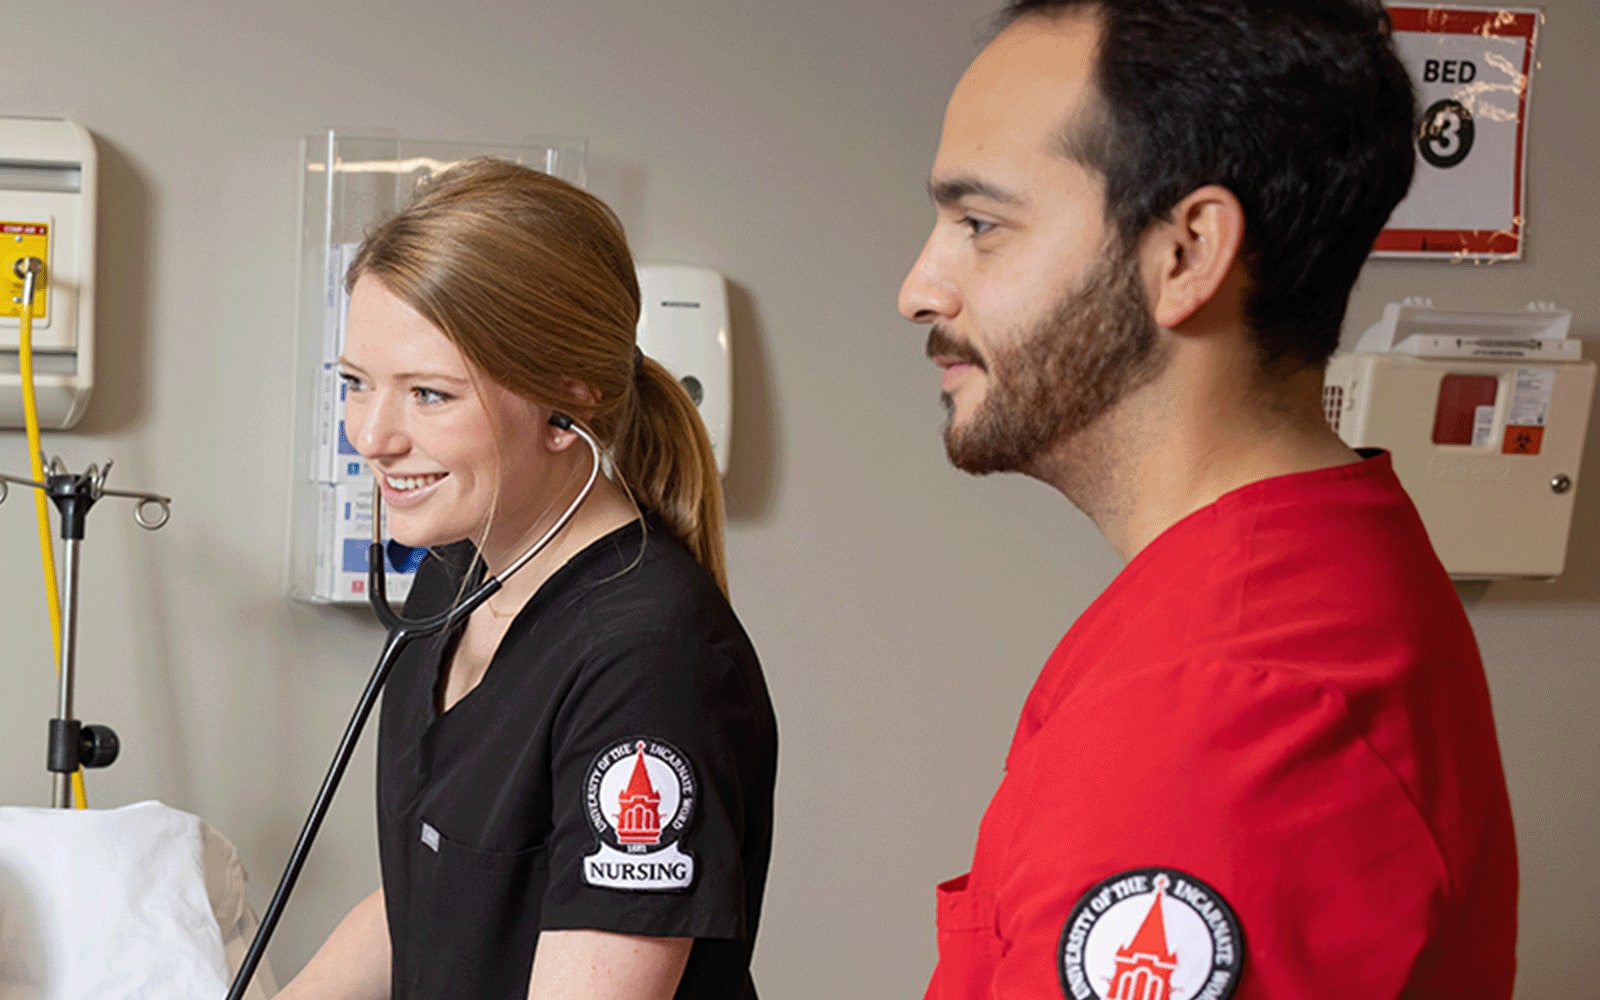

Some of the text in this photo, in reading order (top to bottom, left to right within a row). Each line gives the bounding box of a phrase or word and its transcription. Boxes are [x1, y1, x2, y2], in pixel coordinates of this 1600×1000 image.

[1423, 59, 1476, 83] BED
[1429, 110, 1461, 157] 3
[587, 768, 607, 833] UNIVERSITY
[597, 753, 611, 771] OF
[609, 743, 632, 760] THE
[590, 862, 686, 882] NURSING
[1064, 906, 1097, 1000] UNIVERSITY
[1090, 887, 1111, 912] OF
[1111, 876, 1148, 899] THE
[1173, 879, 1234, 966] INCARNATE
